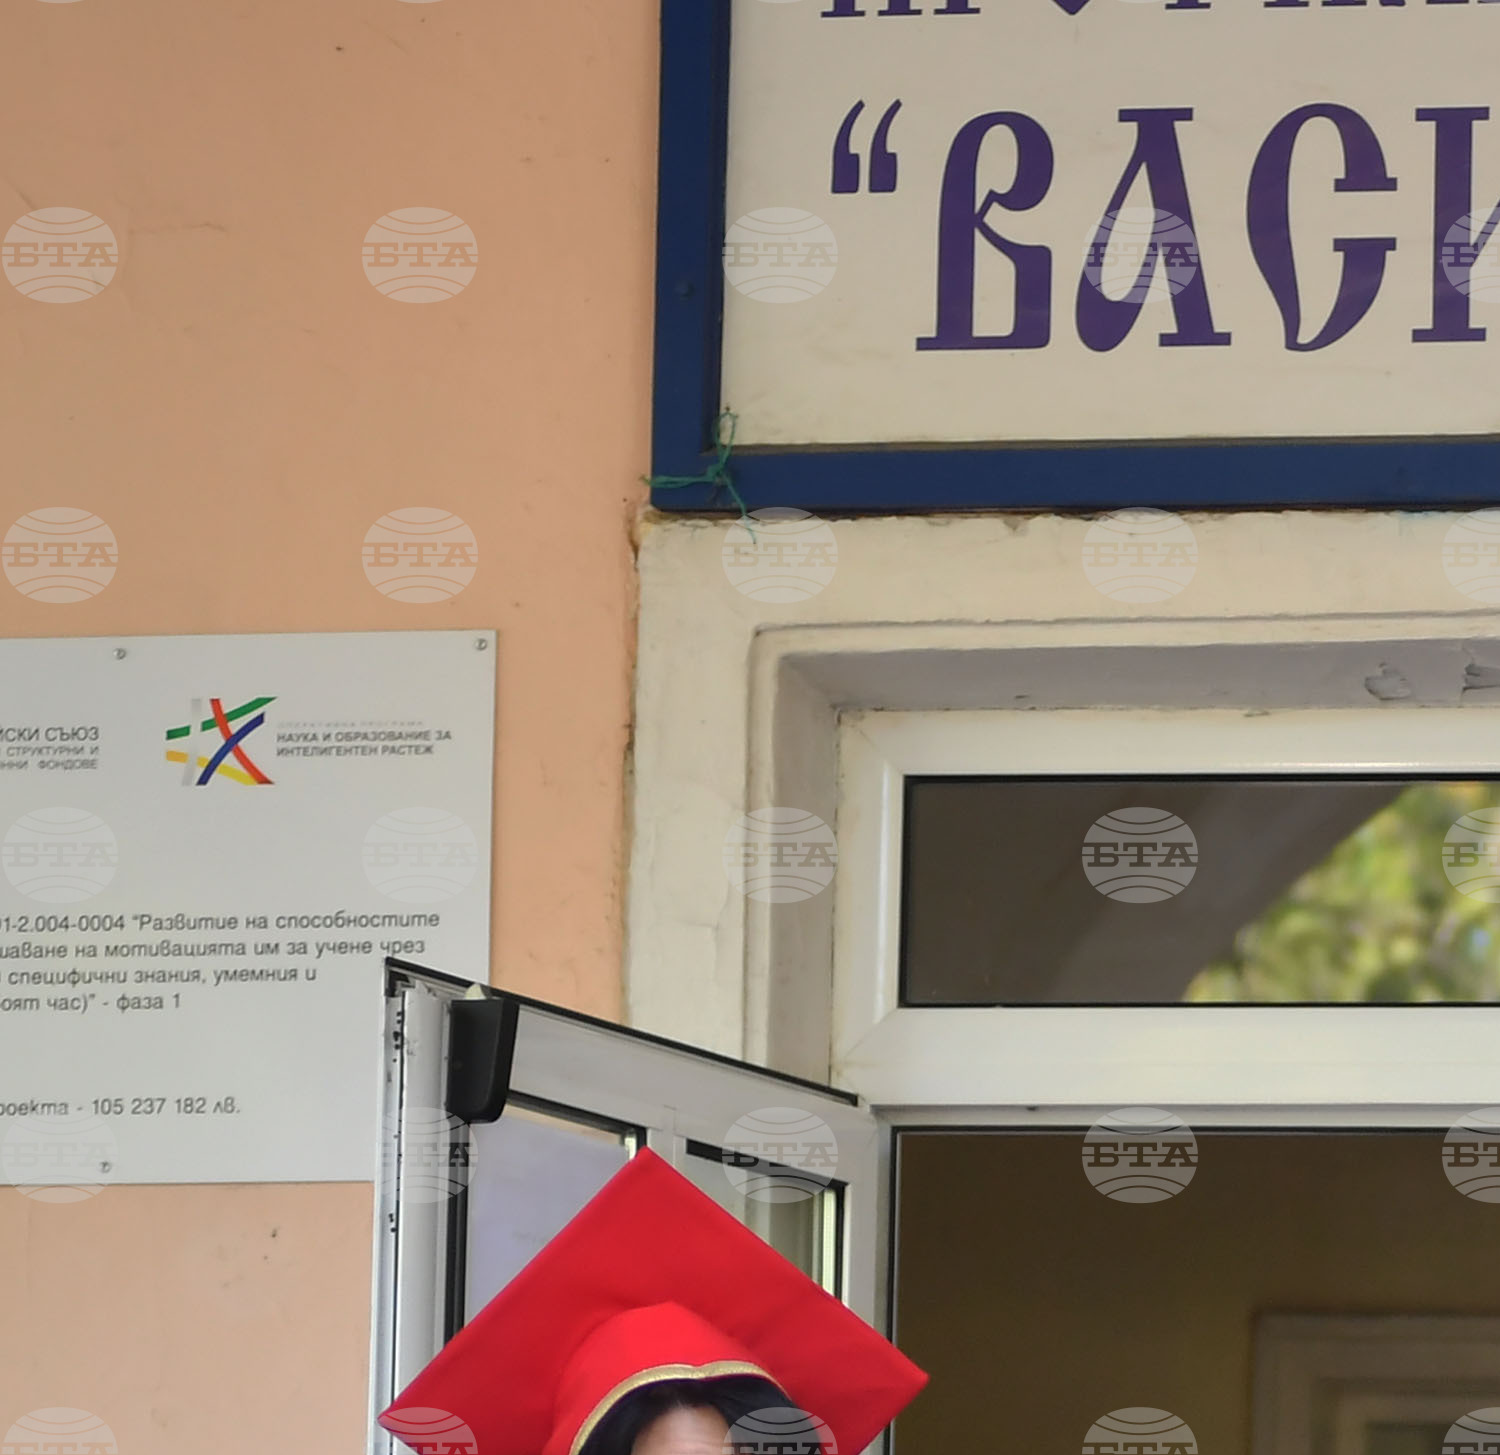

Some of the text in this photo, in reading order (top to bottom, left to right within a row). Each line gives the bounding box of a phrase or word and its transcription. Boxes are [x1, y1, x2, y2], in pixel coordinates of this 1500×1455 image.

[44, 726, 100, 743] СЪЮЗ
[276, 732, 319, 743] НАУКА
[322, 732, 332, 742] И
[435, 729, 452, 741] ЗА
[381, 744, 434, 756] РАСТЕЖ
[0, 914, 126, 933] 1-2.004-0004
[245, 915, 269, 930] на
[275, 909, 440, 930] способностите
[74, 944, 98, 958] на
[104, 939, 247, 958] мотивацията
[253, 942, 280, 956] им
[286, 941, 308, 956] за
[315, 940, 373, 960] учене
[379, 940, 426, 956] чрез
[7, 967, 128, 988] специфични
[305, 968, 317, 982] и
[0, 997, 41, 1012] оят
[116, 993, 164, 1014] фаза
[172, 992, 181, 1009] 1
[92, 1097, 125, 1116] 105
[130, 1097, 167, 1115] 237
[175, 1096, 207, 1115] 182
[212, 1095, 241, 1114] лв.
